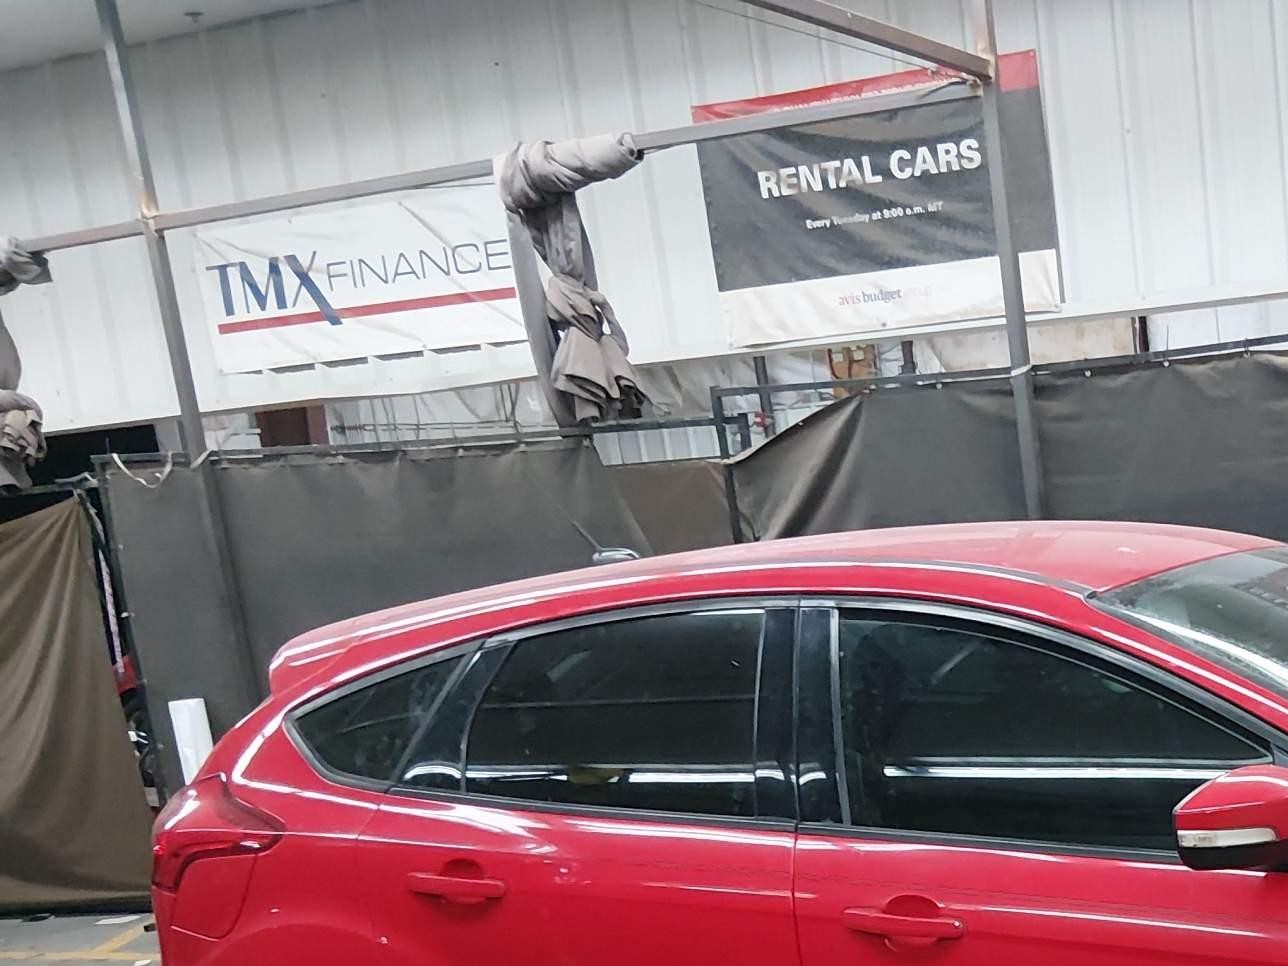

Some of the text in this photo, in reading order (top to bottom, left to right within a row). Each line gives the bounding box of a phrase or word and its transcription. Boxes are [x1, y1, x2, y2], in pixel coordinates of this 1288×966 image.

[757, 138, 982, 199] RENTAL CARS
[805, 217, 831, 230] Every
[871, 211, 882, 221] at
[883, 206, 904, 219] 9:00
[206, 238, 513, 325] TMX FINANCE
[838, 293, 861, 306] avis
[862, 287, 903, 304] budget
